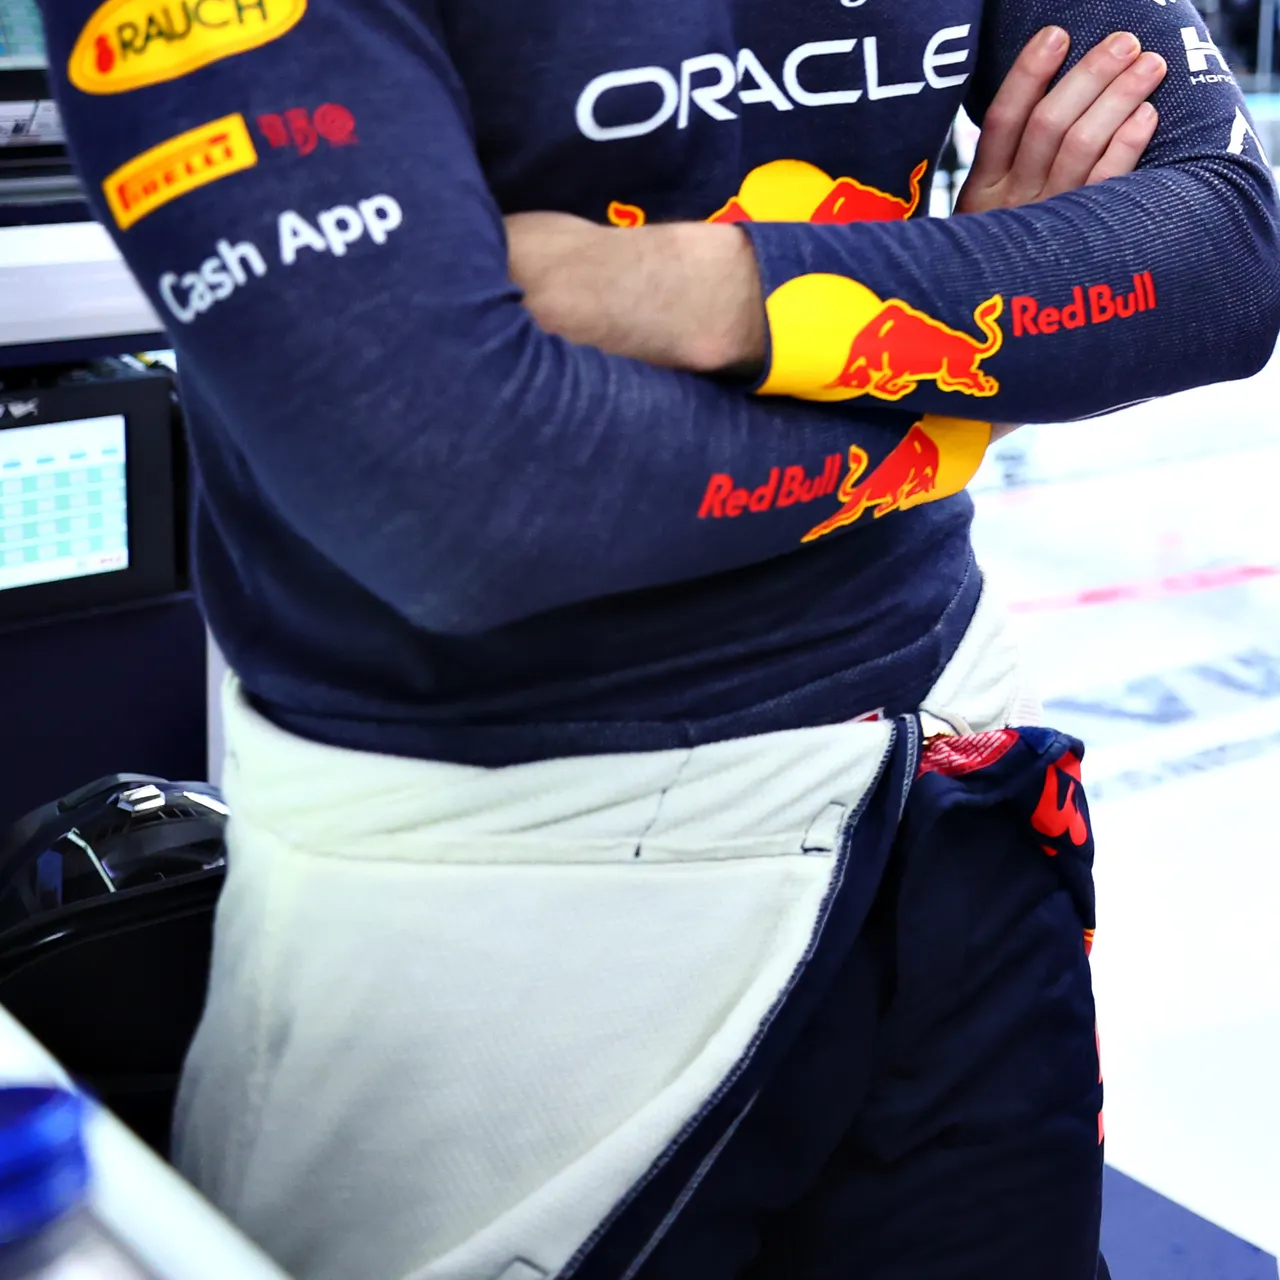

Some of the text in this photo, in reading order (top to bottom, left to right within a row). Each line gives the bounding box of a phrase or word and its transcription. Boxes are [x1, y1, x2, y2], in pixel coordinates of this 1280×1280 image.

[575, 23, 972, 142] ORACLE
[159, 194, 403, 323] Cash App
[1011, 270, 1157, 337] Red Bull
[697, 453, 843, 519] Red Bull
